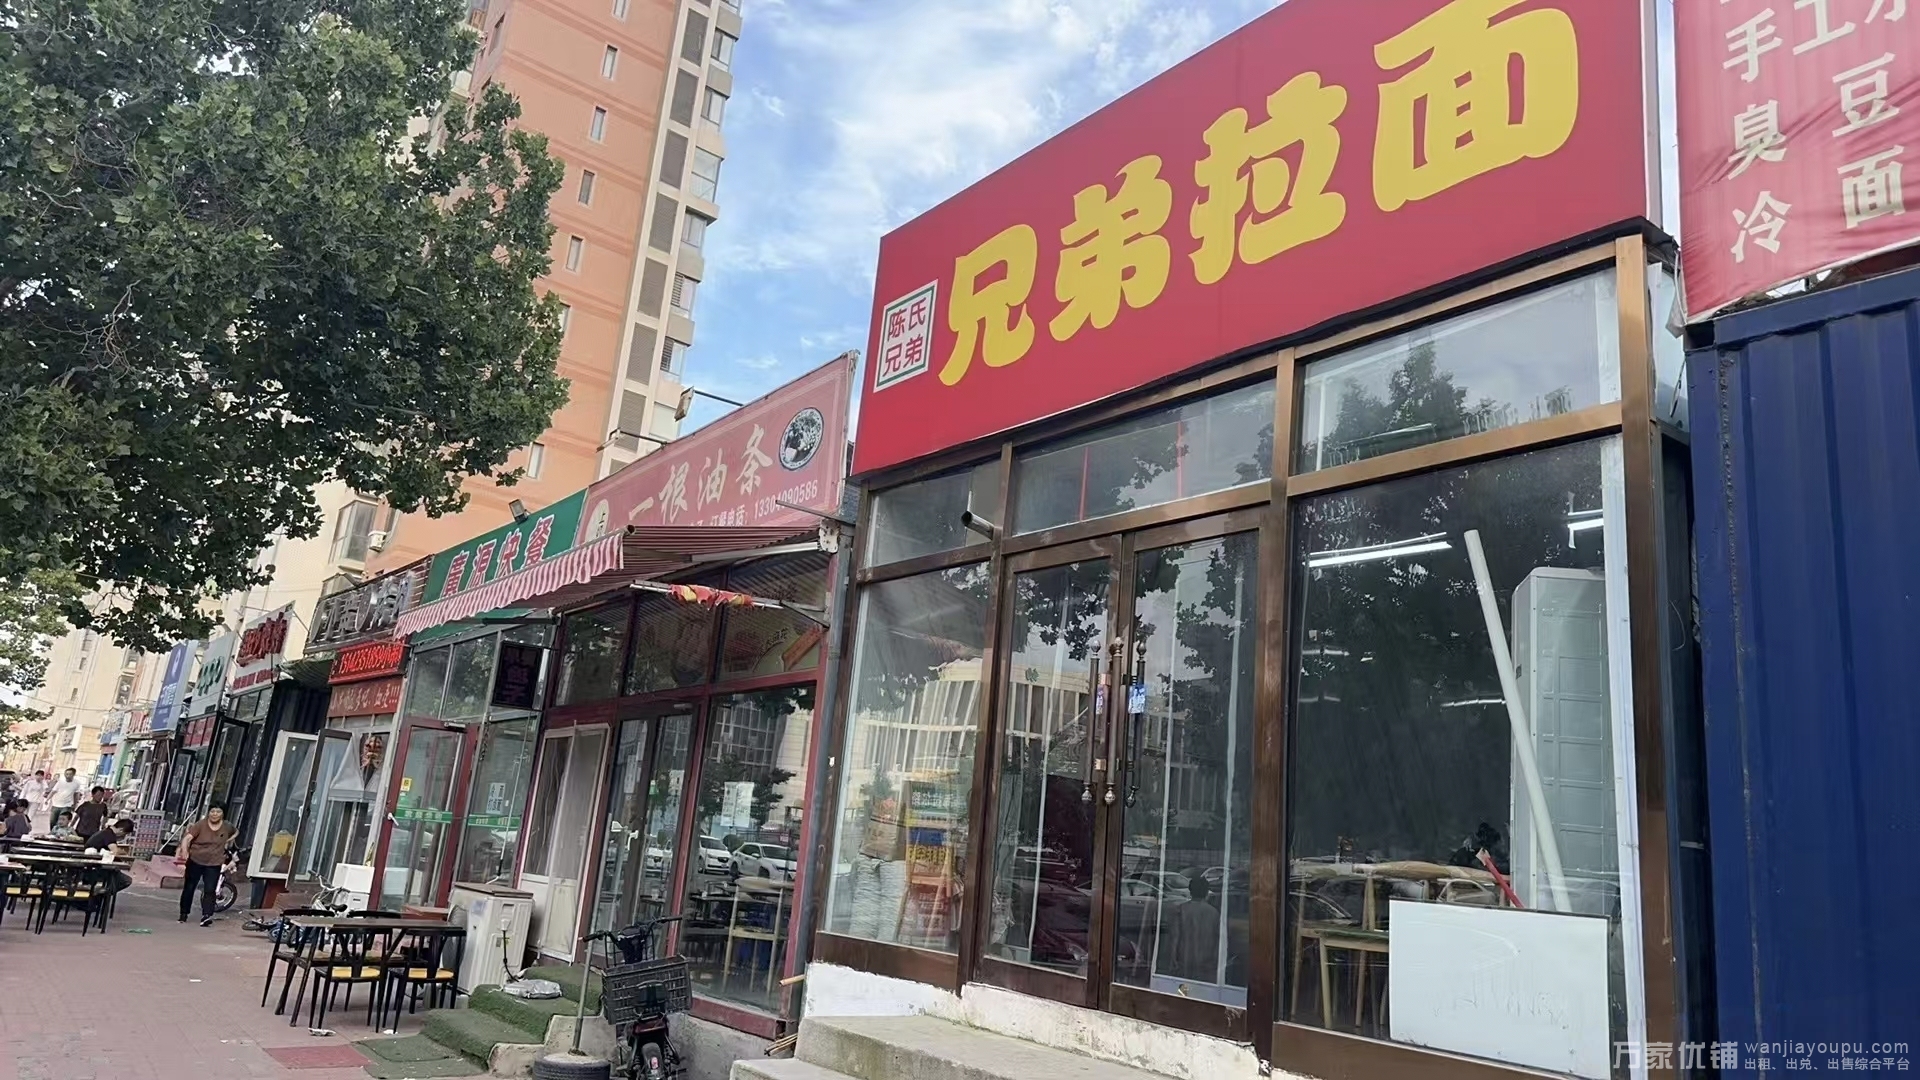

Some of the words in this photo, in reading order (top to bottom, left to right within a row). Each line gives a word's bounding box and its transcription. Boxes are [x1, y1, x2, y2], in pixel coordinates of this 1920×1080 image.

[938, 0, 1579, 386] 兄弟拉面
[1730, 144, 1906, 263] 冷面
[883, 334, 924, 377] 兄弟
[887, 297, 926, 341] 陈氏
[627, 424, 774, 524] 一根油条
